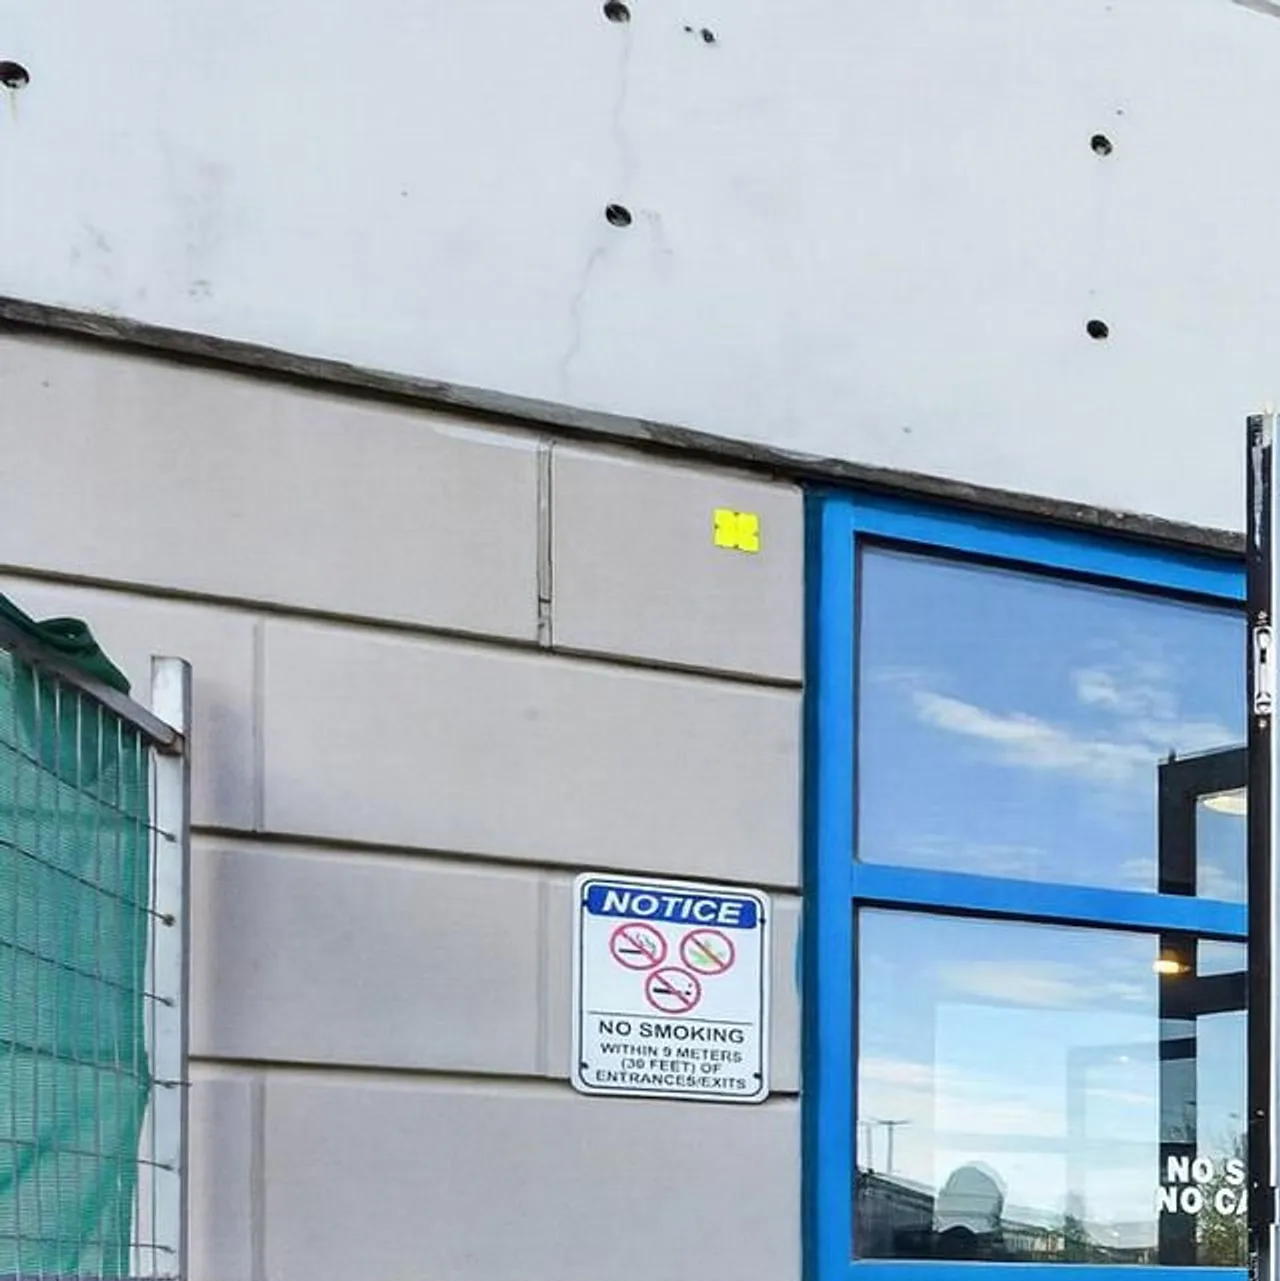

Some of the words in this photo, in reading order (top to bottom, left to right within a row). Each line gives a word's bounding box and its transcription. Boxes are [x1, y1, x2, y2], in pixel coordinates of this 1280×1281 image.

[601, 890, 743, 925] NOTICE
[599, 1020, 632, 1037] NO
[639, 1022, 745, 1044] SMOKING
[600, 1043, 658, 1057] WITHIN
[662, 1046, 672, 1058] 9
[676, 1047, 743, 1063] METERS
[649, 1059, 696, 1074] FEET)
[700, 1062, 723, 1075] OF
[1167, 1156, 1213, 1184] NO
[1156, 1186, 1203, 1214] NO
